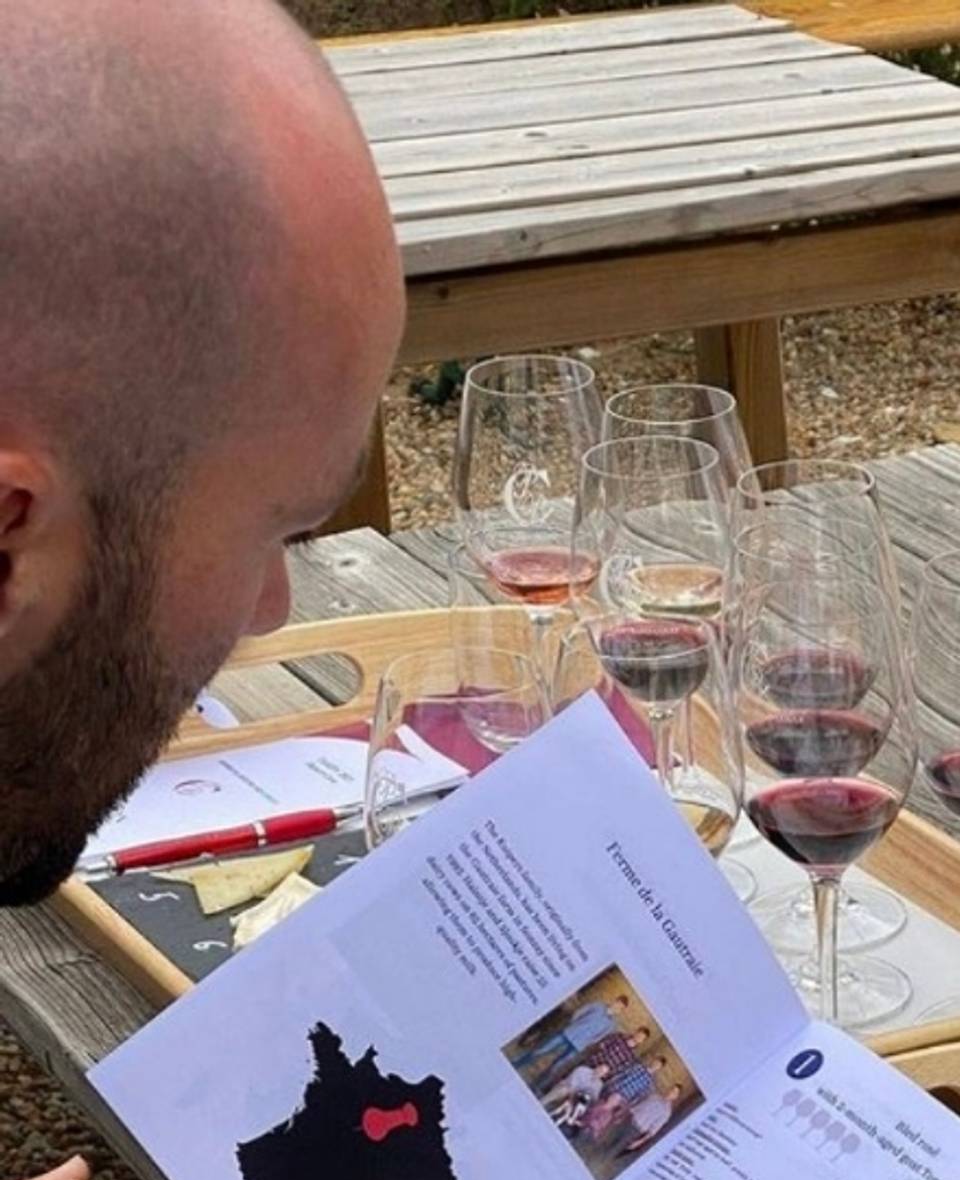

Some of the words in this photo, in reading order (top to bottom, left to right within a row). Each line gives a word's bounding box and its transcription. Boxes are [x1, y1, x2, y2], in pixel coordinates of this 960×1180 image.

[606, 842, 643, 887] Ferme
[637, 885, 656, 905] de
[650, 904, 666, 920] la
[660, 918, 706, 977] Gautraie
